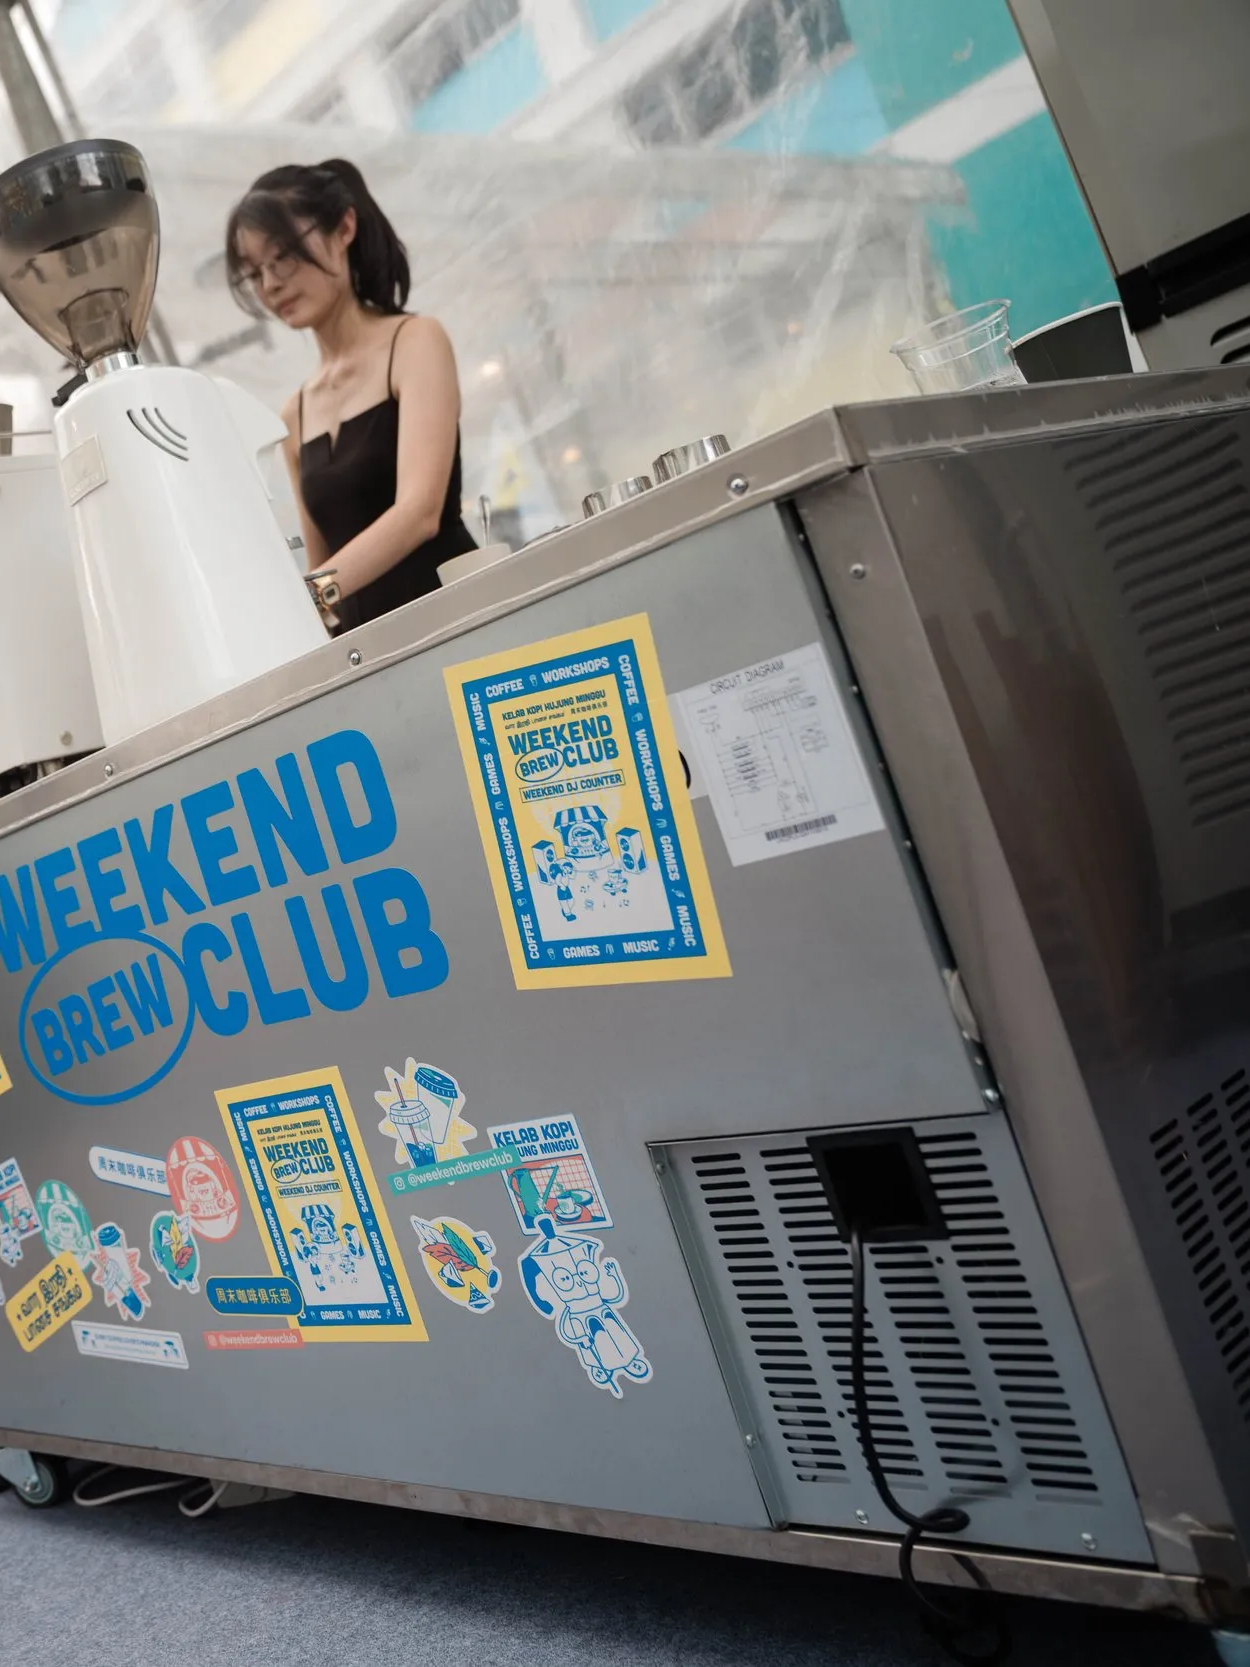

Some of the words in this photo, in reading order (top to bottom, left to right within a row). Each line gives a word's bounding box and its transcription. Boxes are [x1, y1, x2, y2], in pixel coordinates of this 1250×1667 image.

[485, 678, 524, 698] COFFEE
[541, 656, 610, 684] WORKSHOPS
[710, 673, 743, 695] CIRCUIT
[744, 659, 786, 683] DIAGRAM
[470, 692, 487, 731] MUSIC
[502, 708, 526, 721] KELAB
[526, 703, 544, 717] KOPI
[544, 697, 575, 712] HUJUNG
[576, 690, 607, 704] MINGGU
[507, 714, 613, 756] WEEKEND
[483, 752, 502, 796] GAMES
[520, 752, 559, 777] BREW
[563, 738, 620, 768] CLUB
[522, 783, 565, 801] WEEKEND
[567, 780, 581, 793] DJ
[581, 773, 623, 790] COUNTER
[618, 654, 639, 706] COFFEE
[634, 728, 663, 812] WORKSHOPS
[659, 835, 680, 882] GAMES
[676, 905, 697, 947] MUSIC
[498, 816, 523, 893] WORKSHOPS
[520, 913, 540, 960] COFFEE
[563, 945, 600, 959] GAMES
[622, 939, 660, 954] MUSIC
[31, 952, 174, 1076] BREW
[181, 867, 449, 1036] CLUB
[243, 1104, 269, 1118] COFFEE
[277, 1095, 320, 1111] WORKSHOPS
[233, 1112, 249, 1142] MUSIC
[493, 1124, 540, 1149] KELAB
[540, 1120, 575, 1141] KOPI
[263, 1137, 329, 1162] WEEKEND
[517, 1144, 538, 1158] UNG
[540, 1138, 579, 1155] MINGGU
[273, 1160, 299, 1179] BREW
[299, 1155, 336, 1175] CLUB
[407, 1151, 513, 1187] @weekendbrewclub
[279, 1186, 305, 1197] WEEKEND
[313, 1182, 341, 1193] COUNTER
[324, 1095, 342, 1133] COFFEE
[342, 1150, 369, 1214] WORKSHOPS
[369, 1231, 387, 1268] GAMES
[387, 1284, 405, 1318] MUSIC
[265, 1207, 288, 1267] WORKSHOPS
[215, 1287, 292, 1305] 周末咖啡俱乐部
[320, 1309, 345, 1320] GAMES
[357, 1309, 382, 1320] MUSIC
[218, 1332, 298, 1347] @weekendbrewclub
